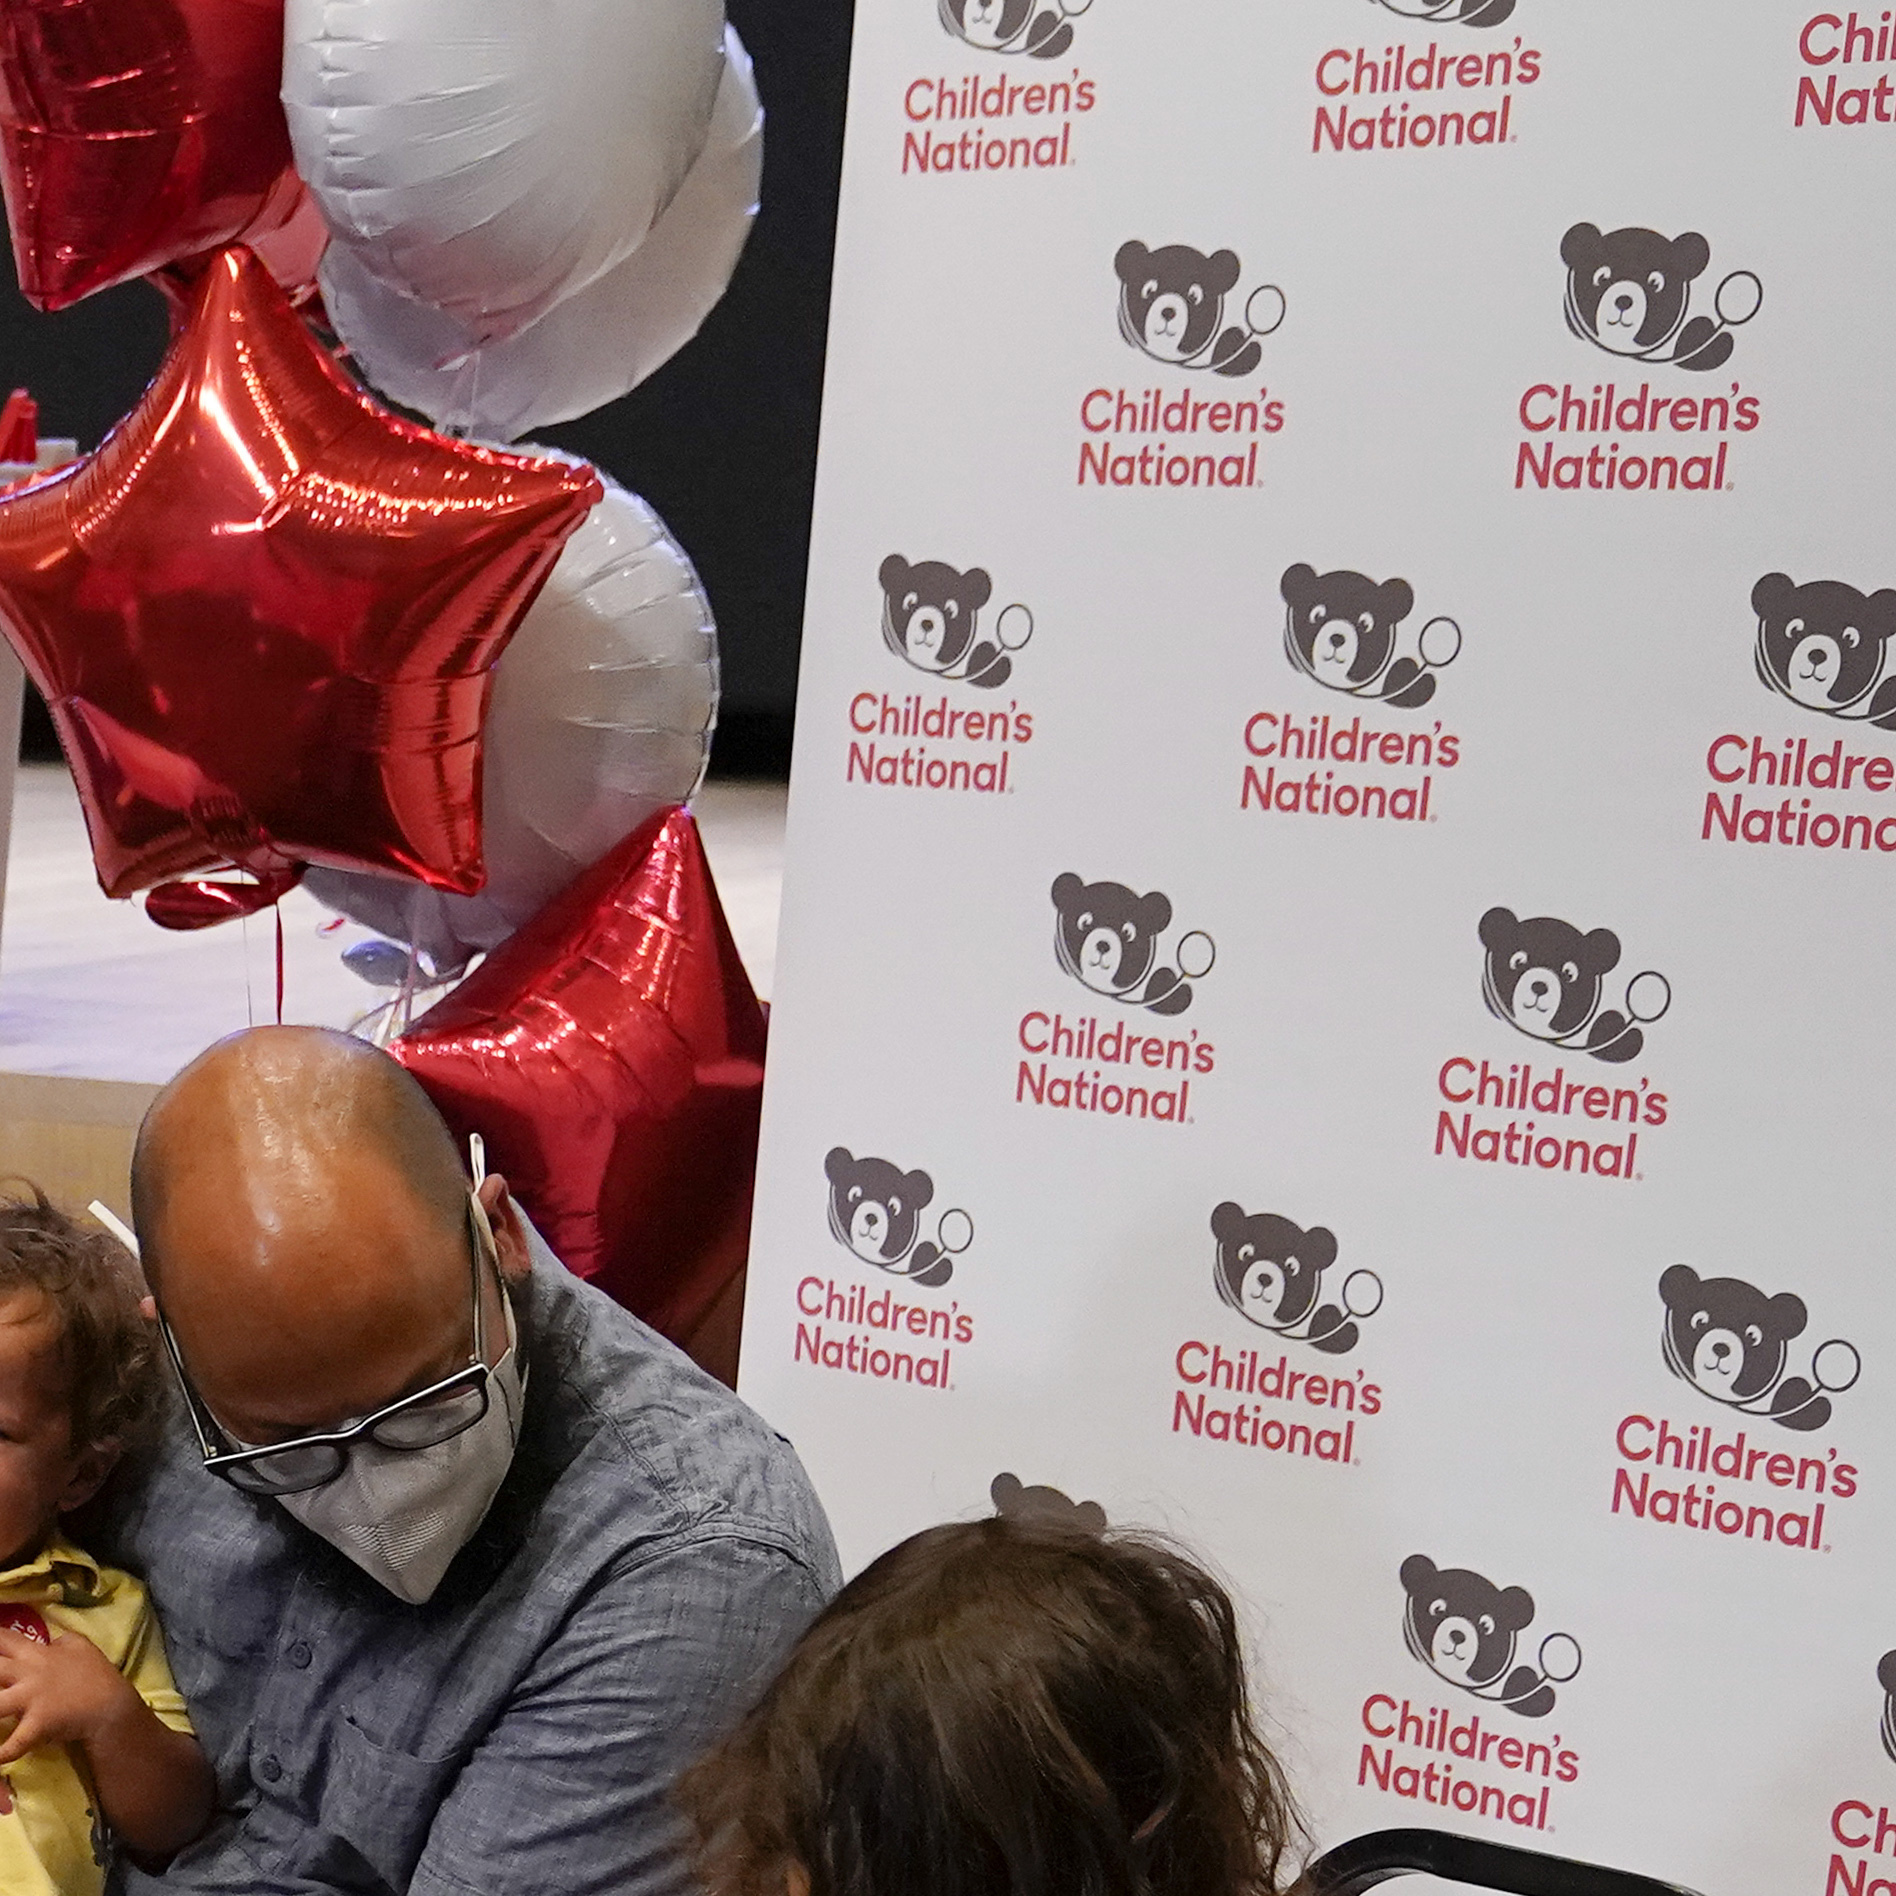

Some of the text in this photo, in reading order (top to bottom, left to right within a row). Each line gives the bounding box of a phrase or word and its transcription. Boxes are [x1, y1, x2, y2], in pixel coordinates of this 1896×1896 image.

[904, 68, 1096, 123] Children's
[1314, 36, 1542, 98] Children's
[900, 122, 1072, 174] National
[1312, 94, 1517, 153] National
[1080, 388, 1285, 436] Children's
[1518, 381, 1761, 433] Children's
[1076, 443, 1256, 488] National
[1514, 441, 1725, 491] National
[849, 692, 1033, 743] Children's
[1243, 712, 1460, 770] Children's
[846, 742, 1009, 793] National
[1706, 734, 1896, 792] Childre
[1240, 766, 1429, 821] National
[1701, 792, 1896, 852] Nationa
[1017, 1011, 1215, 1075] Children's
[1015, 1062, 1189, 1123] National
[1437, 1056, 1668, 1128] Children's
[1434, 1112, 1638, 1180] National
[795, 1276, 974, 1344] Children's
[793, 1324, 951, 1389] National
[1175, 1341, 1382, 1416] Children's
[1172, 1392, 1354, 1464] National
[1615, 1413, 1859, 1499] Children's
[1610, 1469, 1825, 1550] National
[1361, 1693, 1580, 1783] Children's
[1358, 1744, 1549, 1831] National
